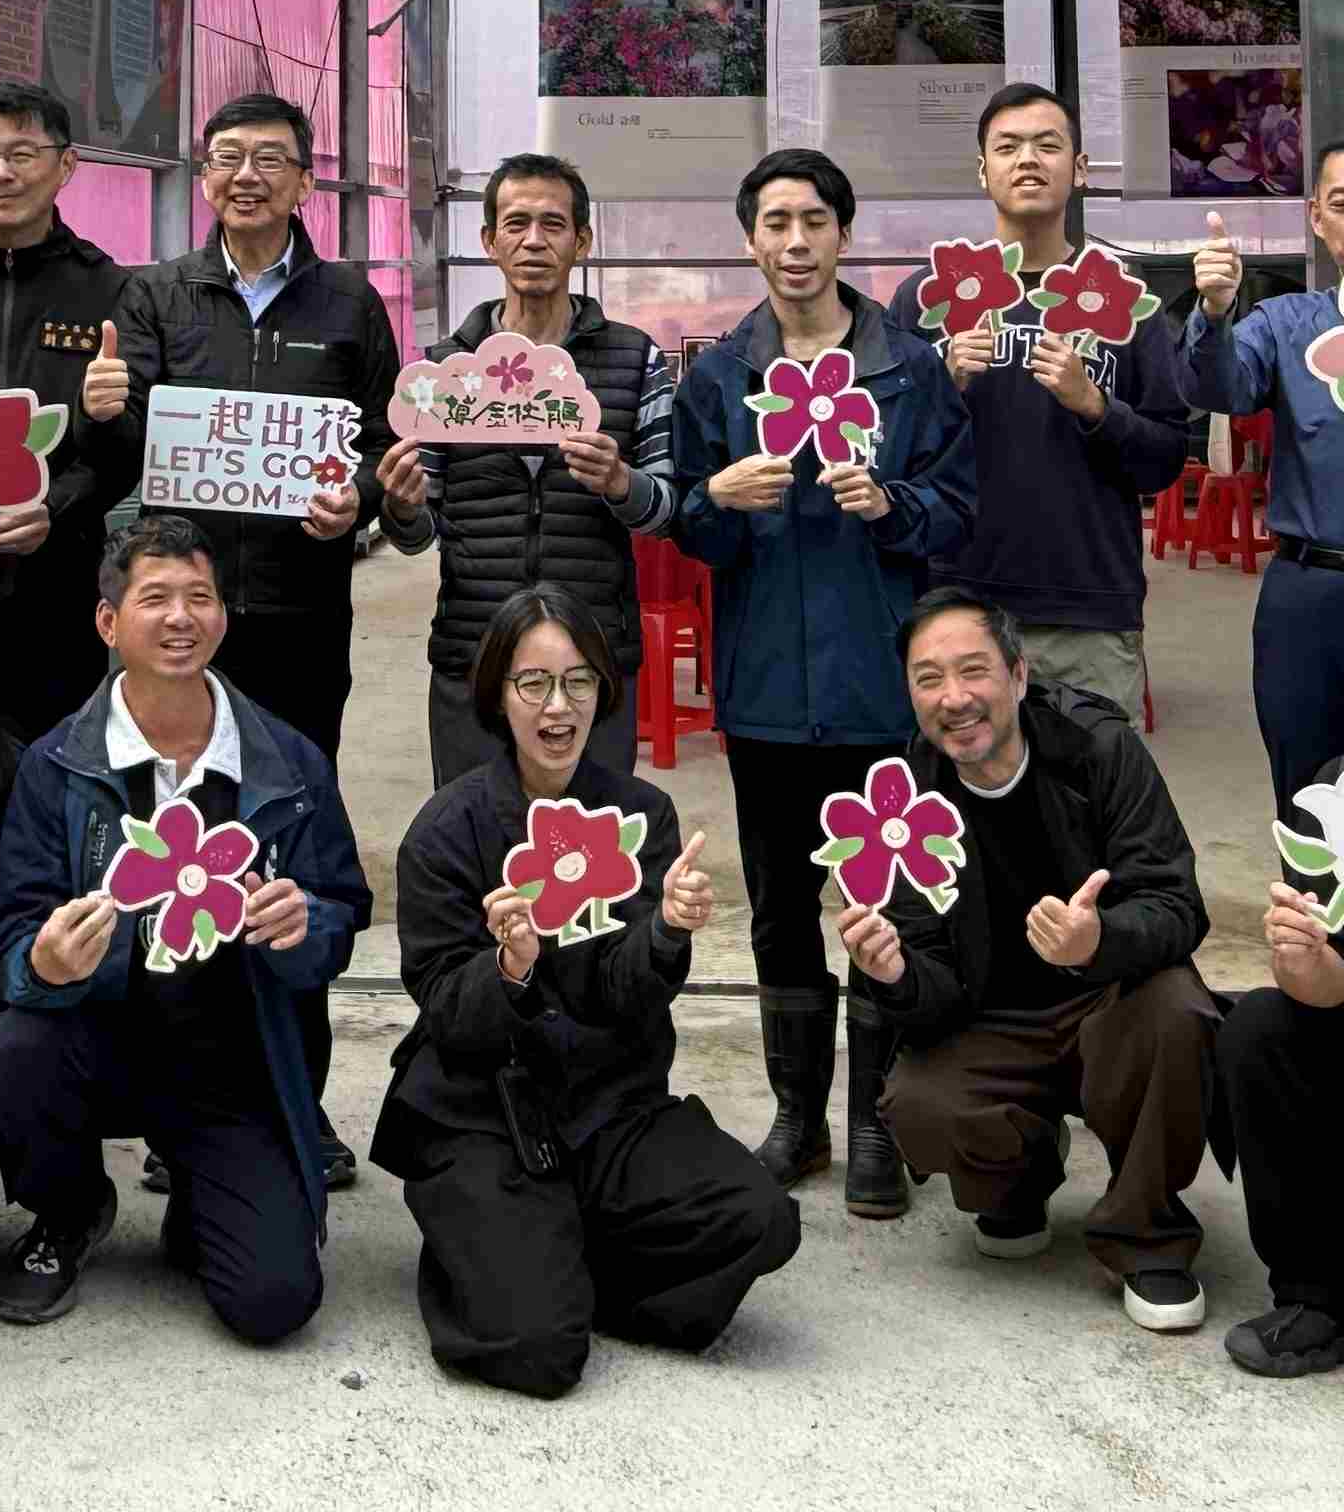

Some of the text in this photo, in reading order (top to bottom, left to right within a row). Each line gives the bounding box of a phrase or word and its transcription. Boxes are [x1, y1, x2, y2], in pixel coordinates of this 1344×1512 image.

[153, 396, 358, 460] 一起出花
[149, 444, 314, 480] LET'S GO
[146, 475, 282, 510] BLOOM
